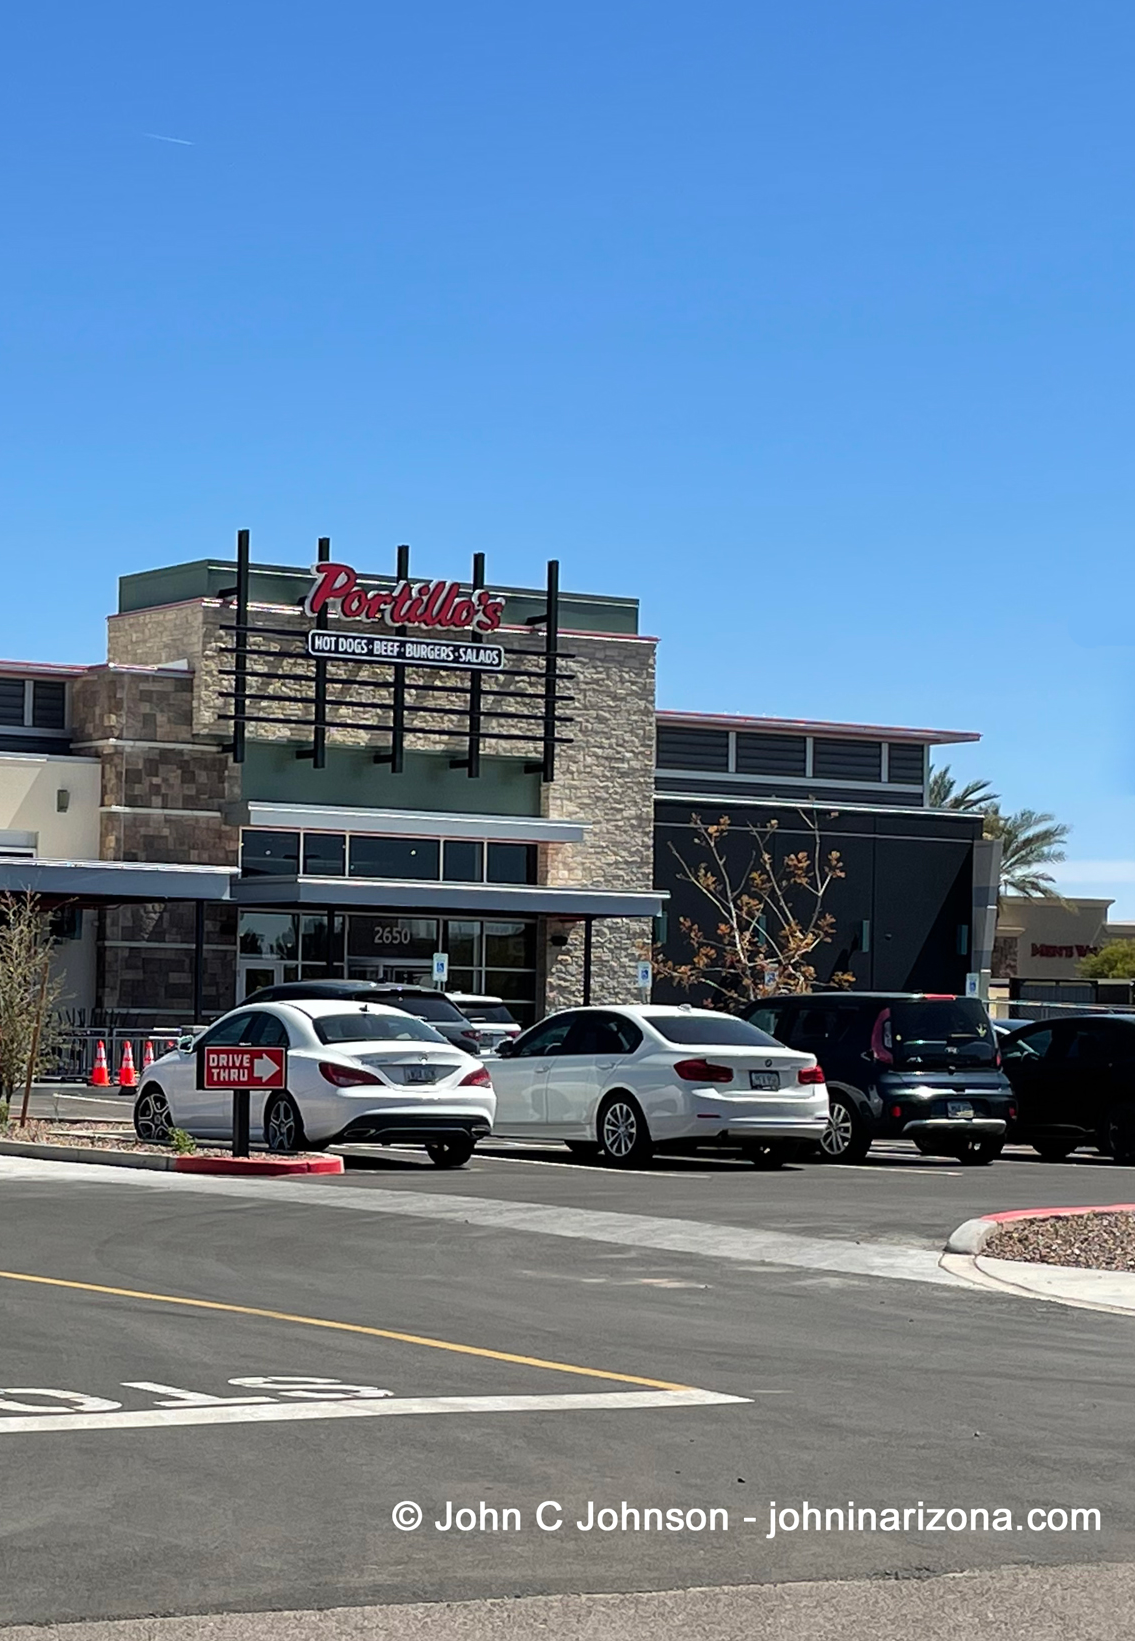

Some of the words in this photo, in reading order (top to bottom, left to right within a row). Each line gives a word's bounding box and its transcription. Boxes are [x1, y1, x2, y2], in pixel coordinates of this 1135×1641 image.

[308, 562, 504, 633] Portillo's
[314, 635, 337, 651] HOT
[338, 637, 368, 654] DOGS
[373, 640, 400, 656] BEEF
[405, 643, 454, 661] BURGERS
[458, 647, 499, 665] SALADS
[374, 926, 410, 944] 2650
[209, 1054, 251, 1067] DRIVE
[211, 1068, 248, 1082] THRU
